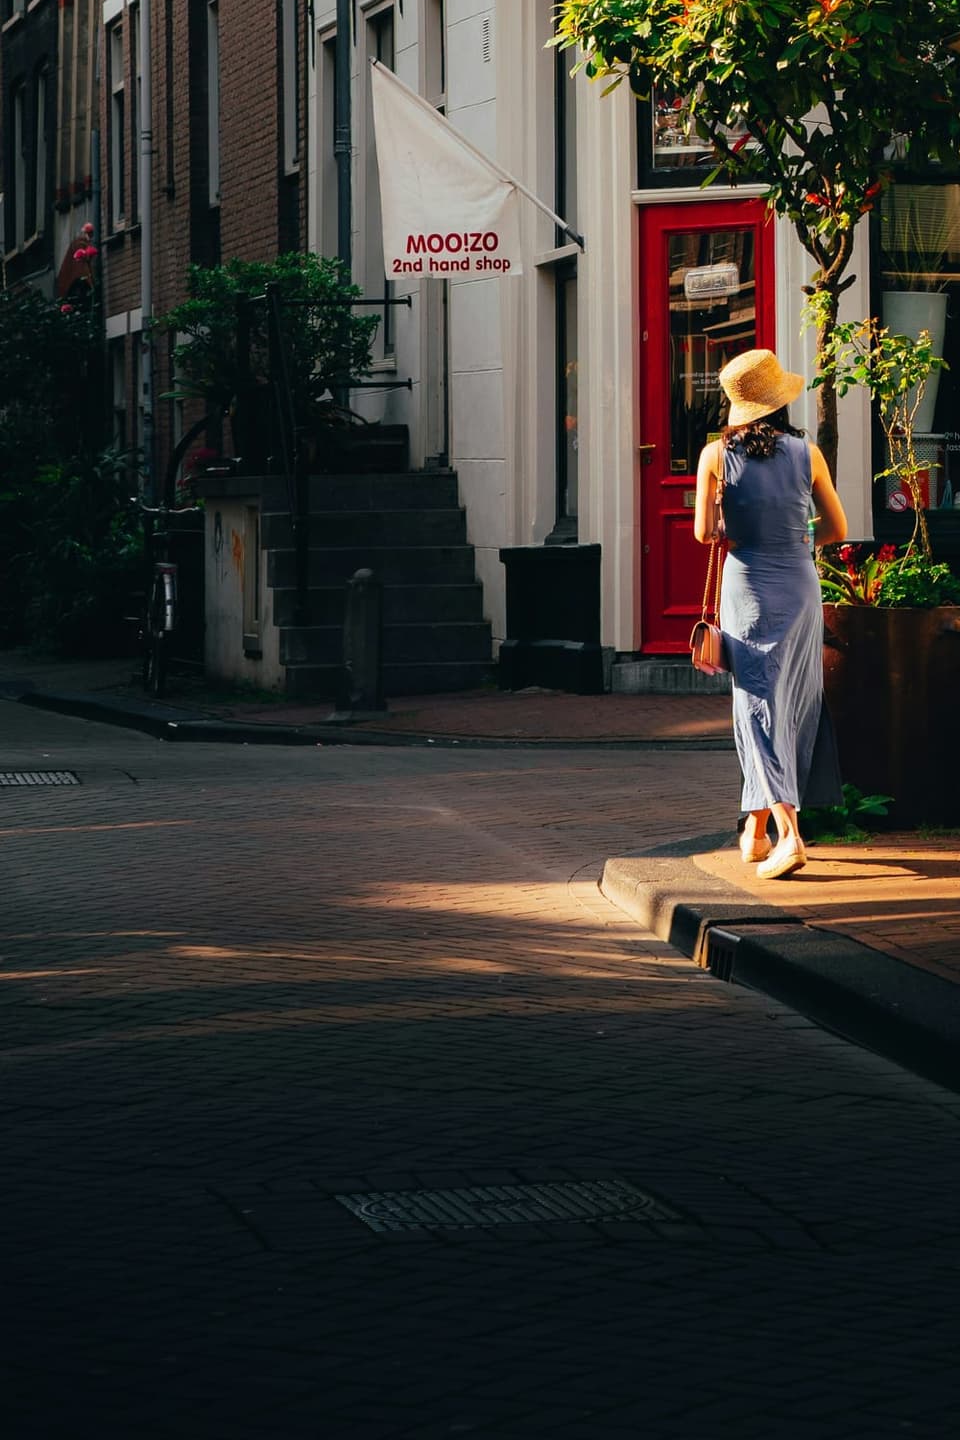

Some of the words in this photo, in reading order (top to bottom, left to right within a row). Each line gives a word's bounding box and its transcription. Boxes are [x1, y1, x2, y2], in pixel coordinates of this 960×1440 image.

[393, 257, 423, 273] 2nd
[429, 256, 470, 272] hand
[475, 255, 511, 273] shop
